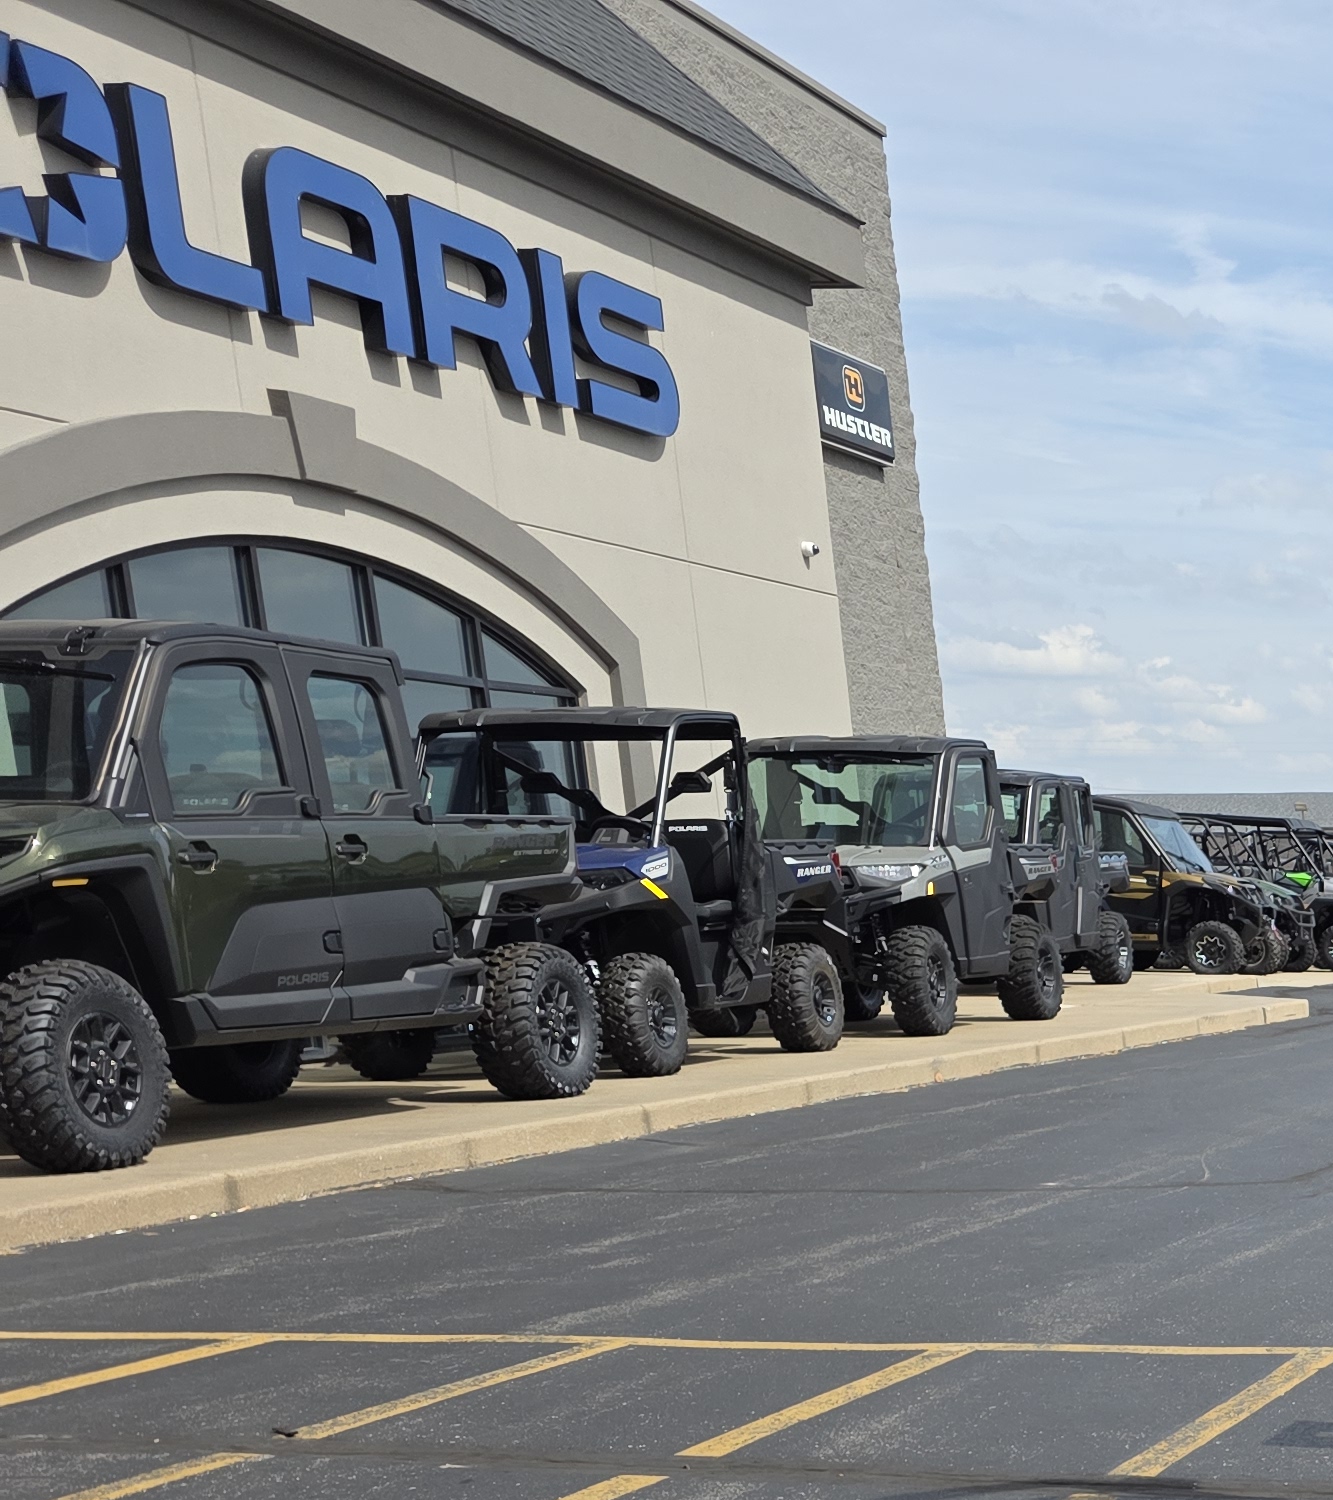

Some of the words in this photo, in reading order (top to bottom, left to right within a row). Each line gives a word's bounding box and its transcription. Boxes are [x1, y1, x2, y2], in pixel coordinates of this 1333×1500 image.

[0, 31, 680, 438] OLARIS
[822, 405, 892, 448] HUSTLER
[930, 854, 947, 864] XP
[645, 862, 667, 873] 1000
[797, 865, 832, 877] RANGER
[1028, 866, 1052, 875] RANGER
[277, 971, 330, 987] POLARIS
